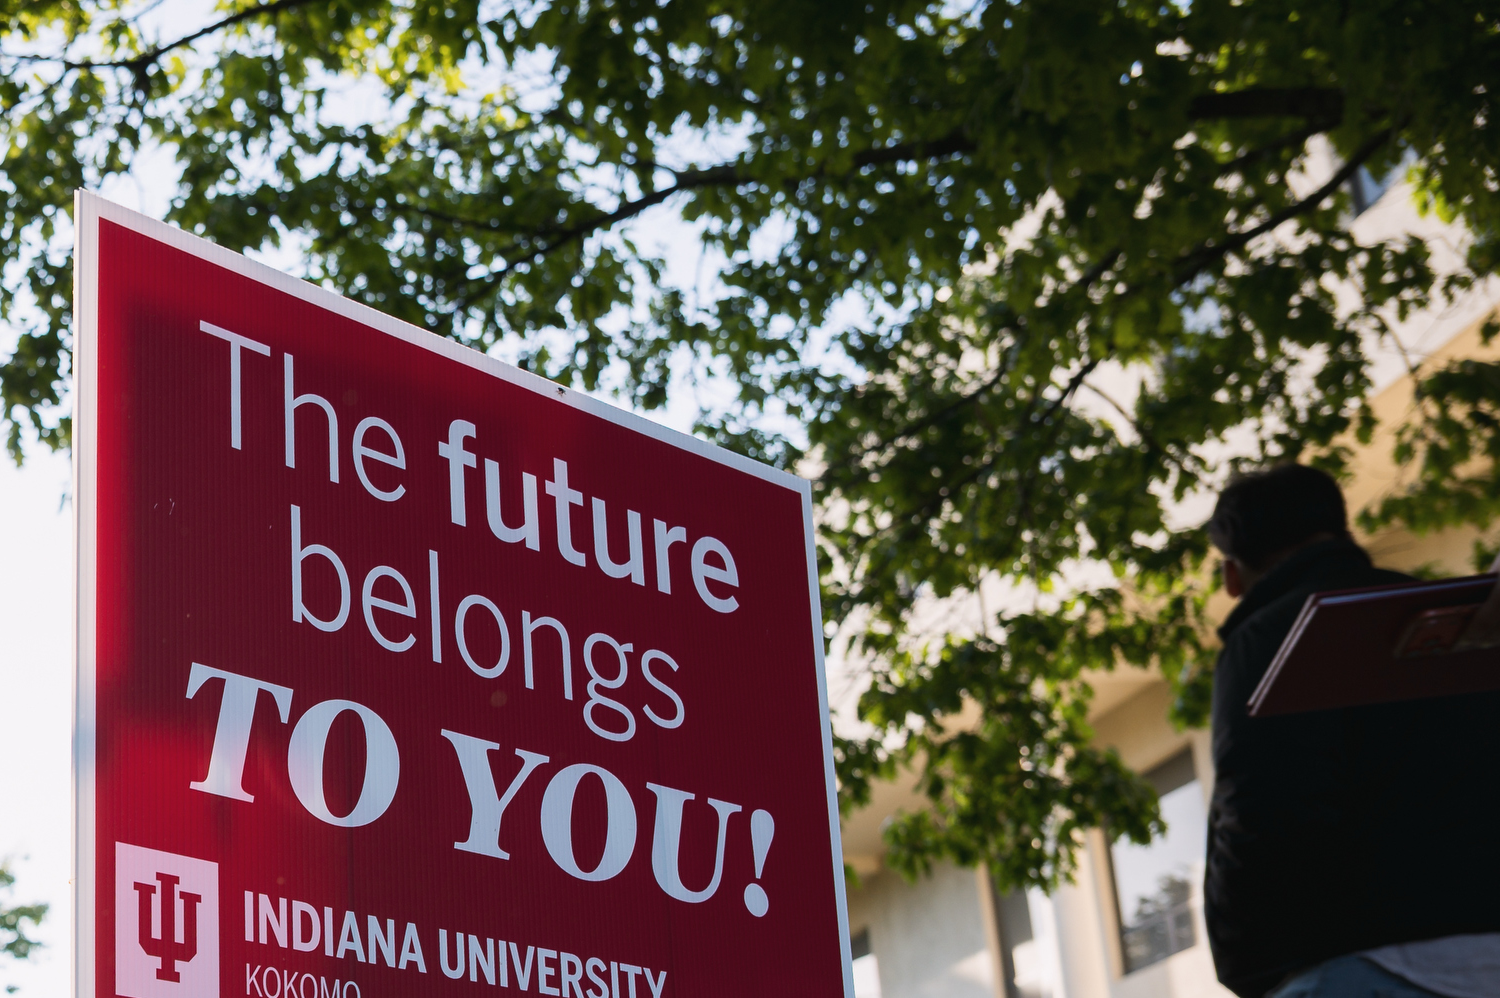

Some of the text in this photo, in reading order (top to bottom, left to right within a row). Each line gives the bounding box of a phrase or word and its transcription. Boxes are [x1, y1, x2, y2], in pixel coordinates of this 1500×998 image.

[199, 319, 740, 615] The future
[290, 503, 685, 742] belongs
[185, 661, 775, 918] TO YOU!
[244, 890, 427, 974] INDIANA
